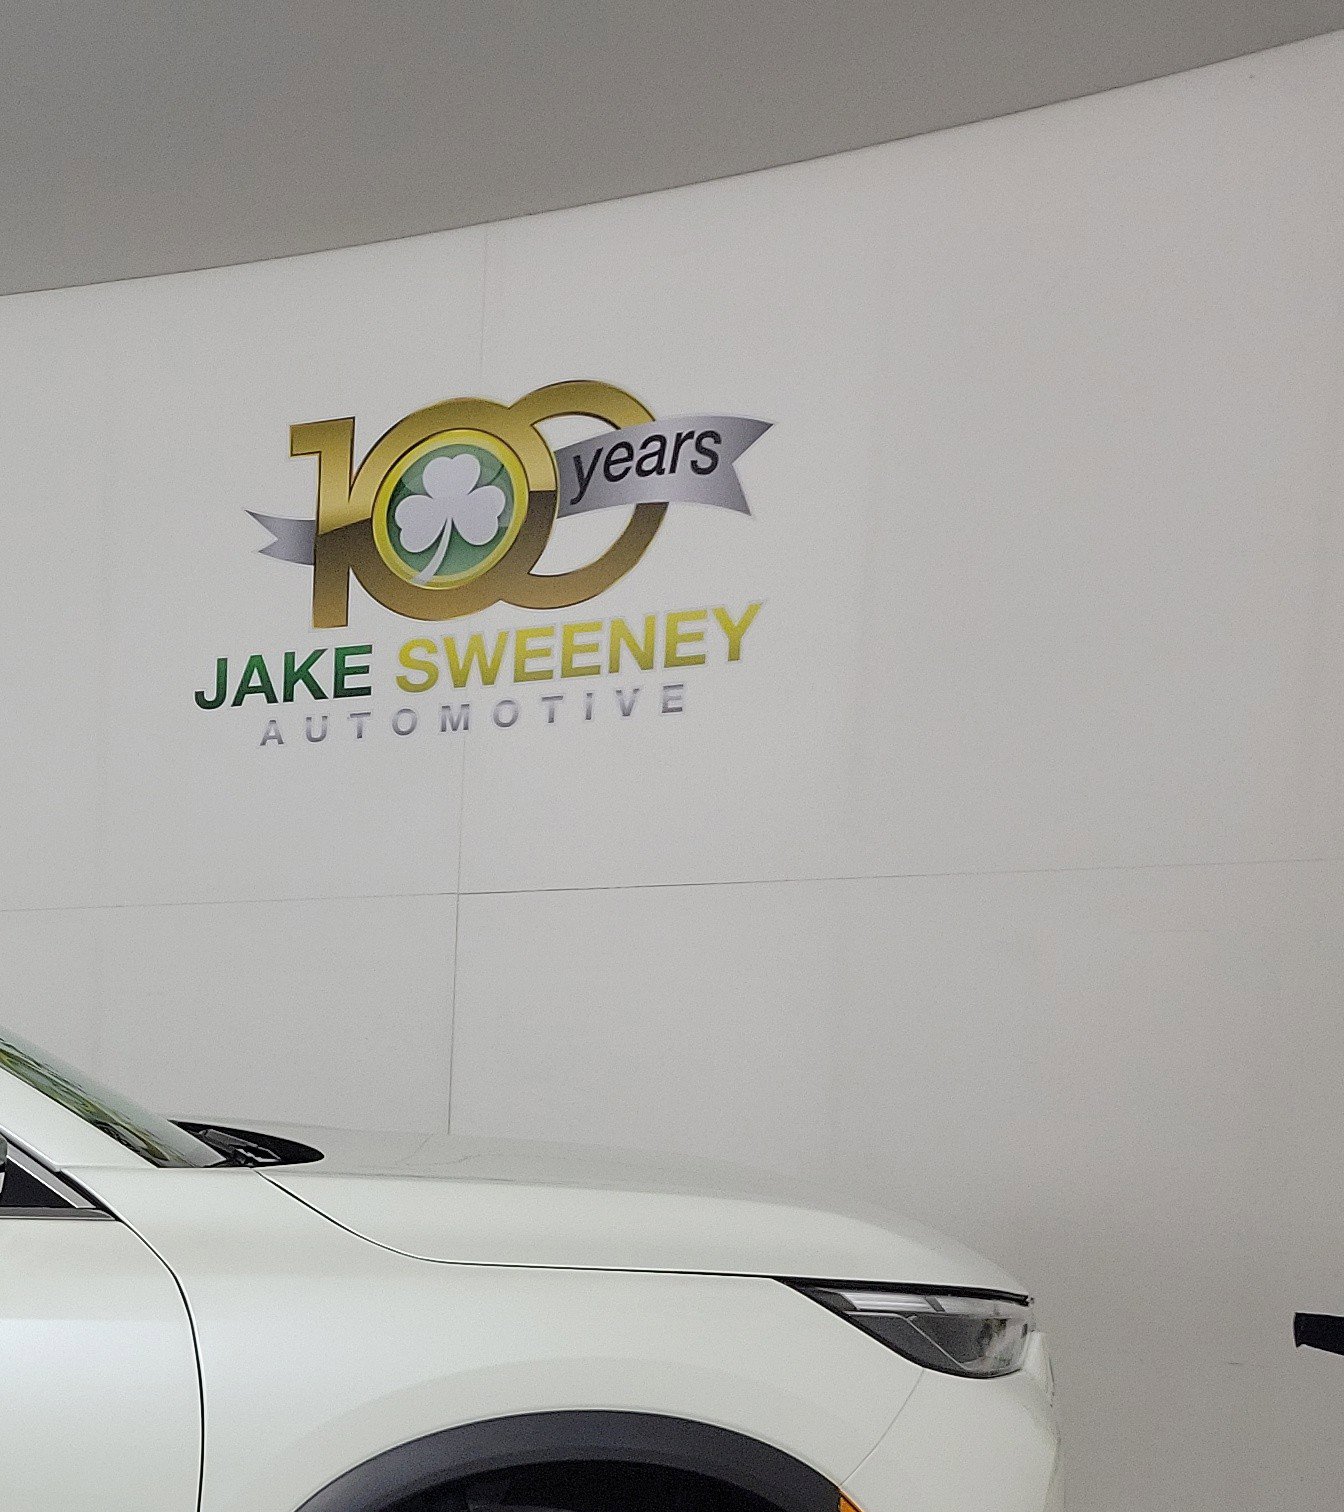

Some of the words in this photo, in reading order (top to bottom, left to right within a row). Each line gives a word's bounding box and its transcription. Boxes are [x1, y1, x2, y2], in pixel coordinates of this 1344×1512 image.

[290, 380, 670, 628] 100
[569, 427, 722, 505] years
[194, 643, 374, 711] JAKE
[395, 600, 766, 694] SWEENEY
[259, 684, 685, 748] AUTOMOTIVE
